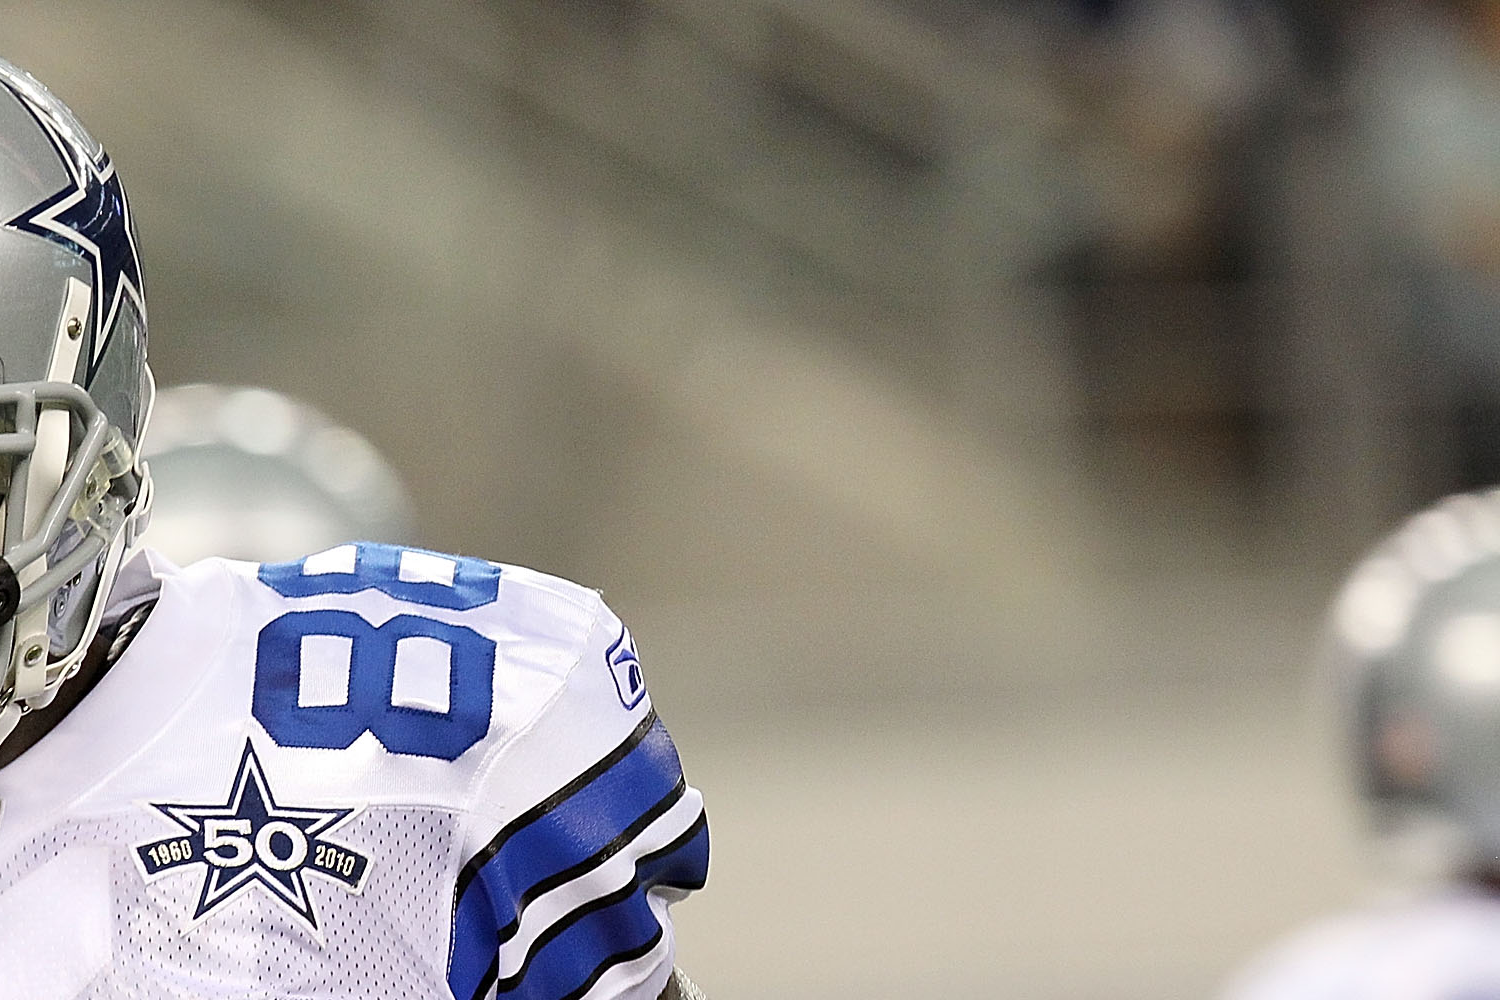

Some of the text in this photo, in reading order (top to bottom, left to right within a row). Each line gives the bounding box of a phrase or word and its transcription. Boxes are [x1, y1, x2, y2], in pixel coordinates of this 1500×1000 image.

[252, 541, 501, 763] 88
[148, 819, 356, 877] 1960 50 2010
